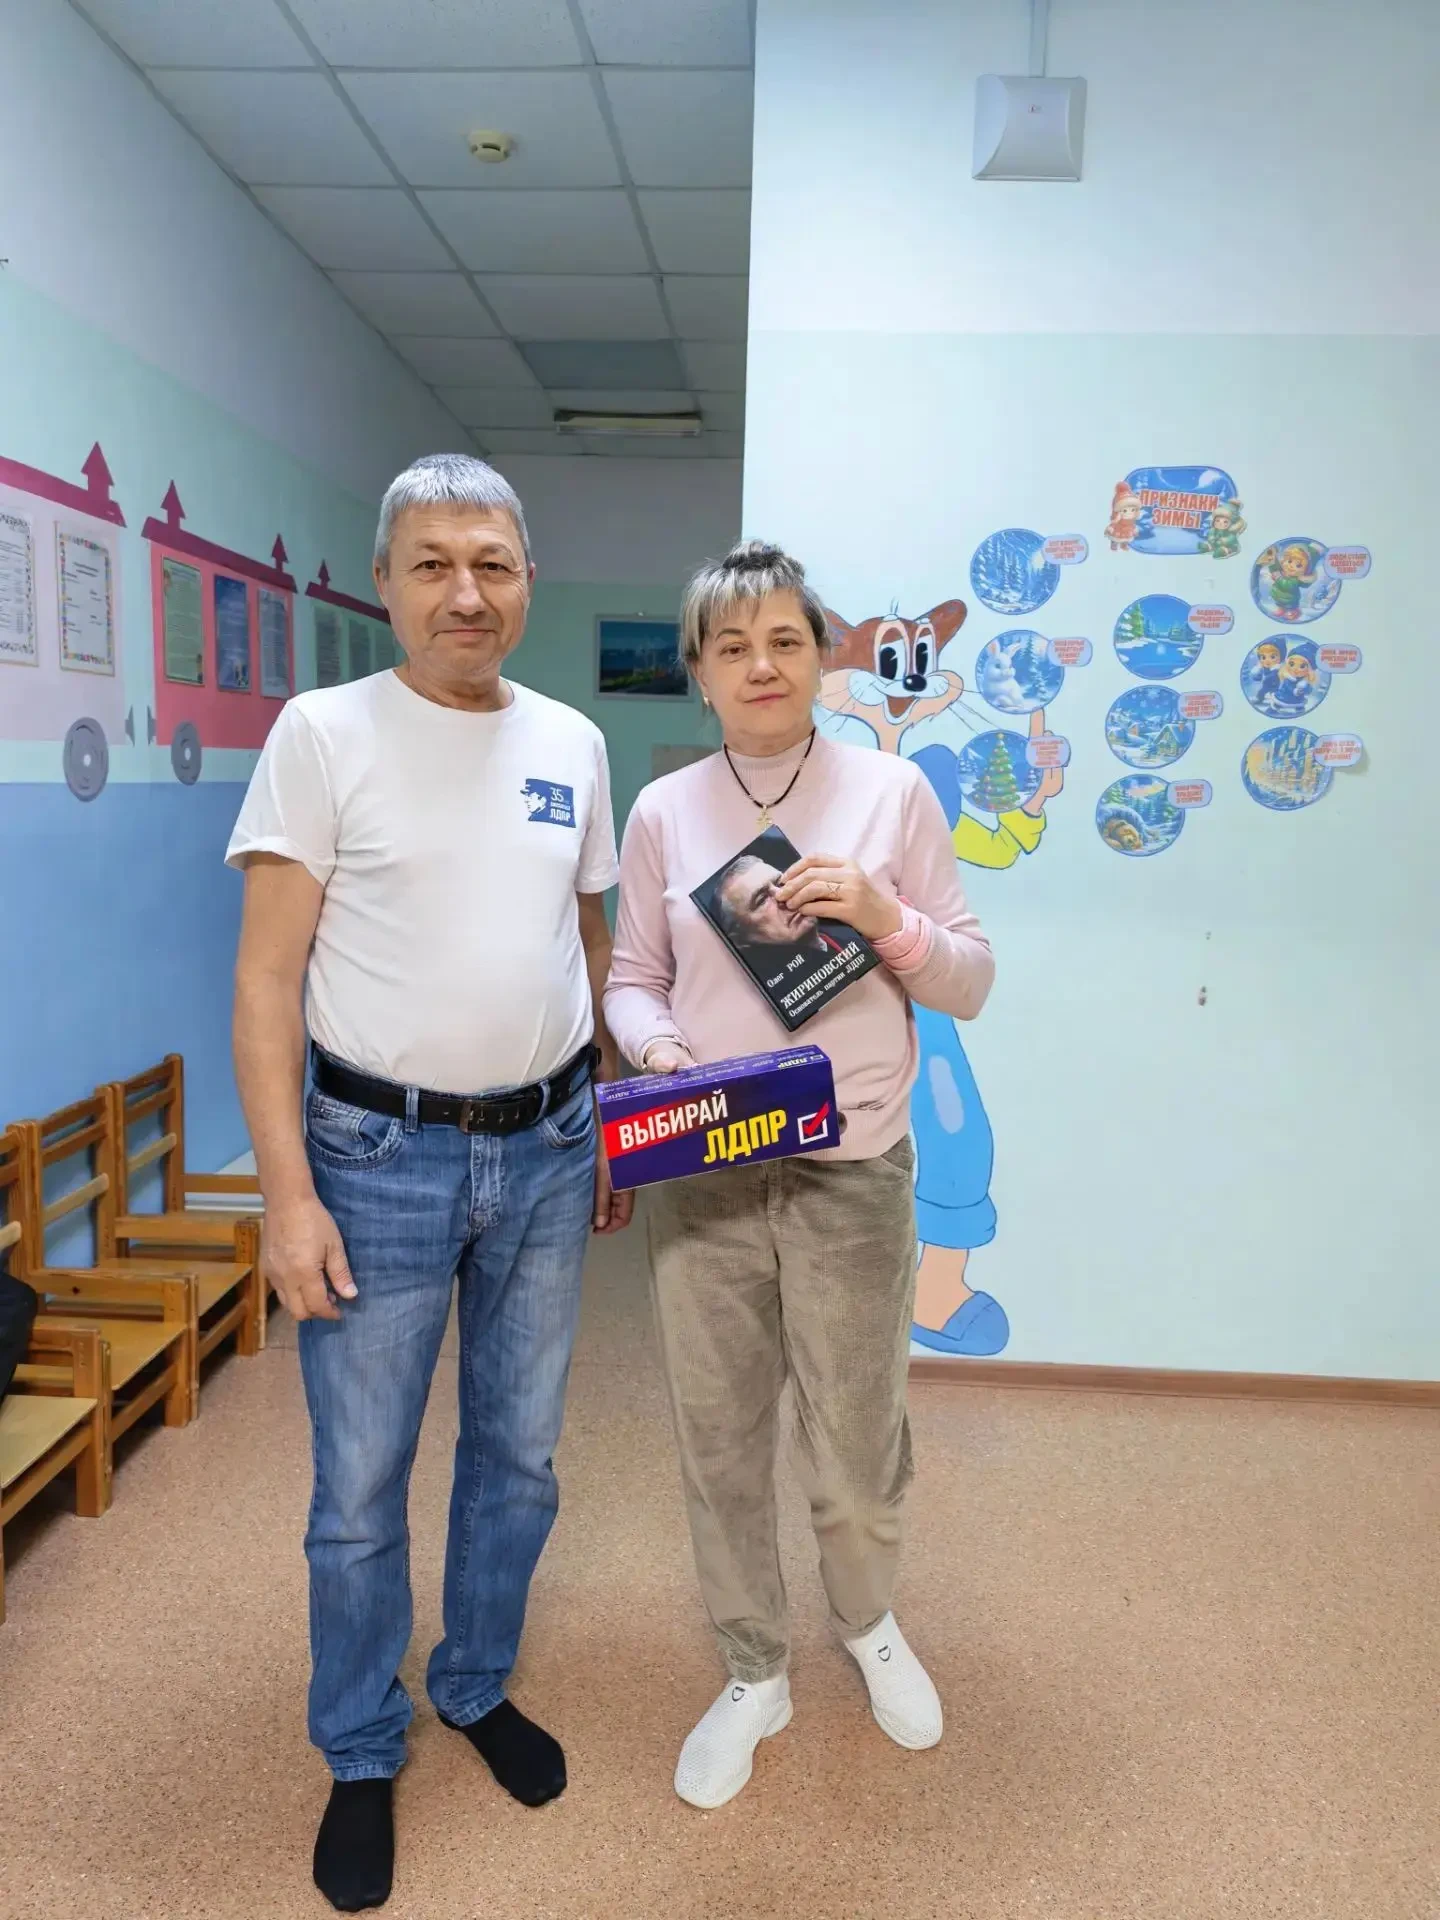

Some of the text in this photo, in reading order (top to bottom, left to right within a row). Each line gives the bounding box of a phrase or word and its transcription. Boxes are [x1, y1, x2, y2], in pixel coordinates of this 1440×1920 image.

[1140, 490, 1219, 511] ПРИЗНАКИ
[1152, 508, 1200, 528] ЗИМЫ
[550, 787, 564, 802] 35
[549, 808, 571, 822] ЛДПР
[767, 954, 805, 987] Олег РОЙ
[780, 941, 860, 1009] ЖИРИНОВСКИЙ
[788, 954, 865, 1017] Основатель партии ЛДПР
[619, 1088, 729, 1151] ВЫБИРАЙ
[703, 1109, 787, 1164] ЛДПР
